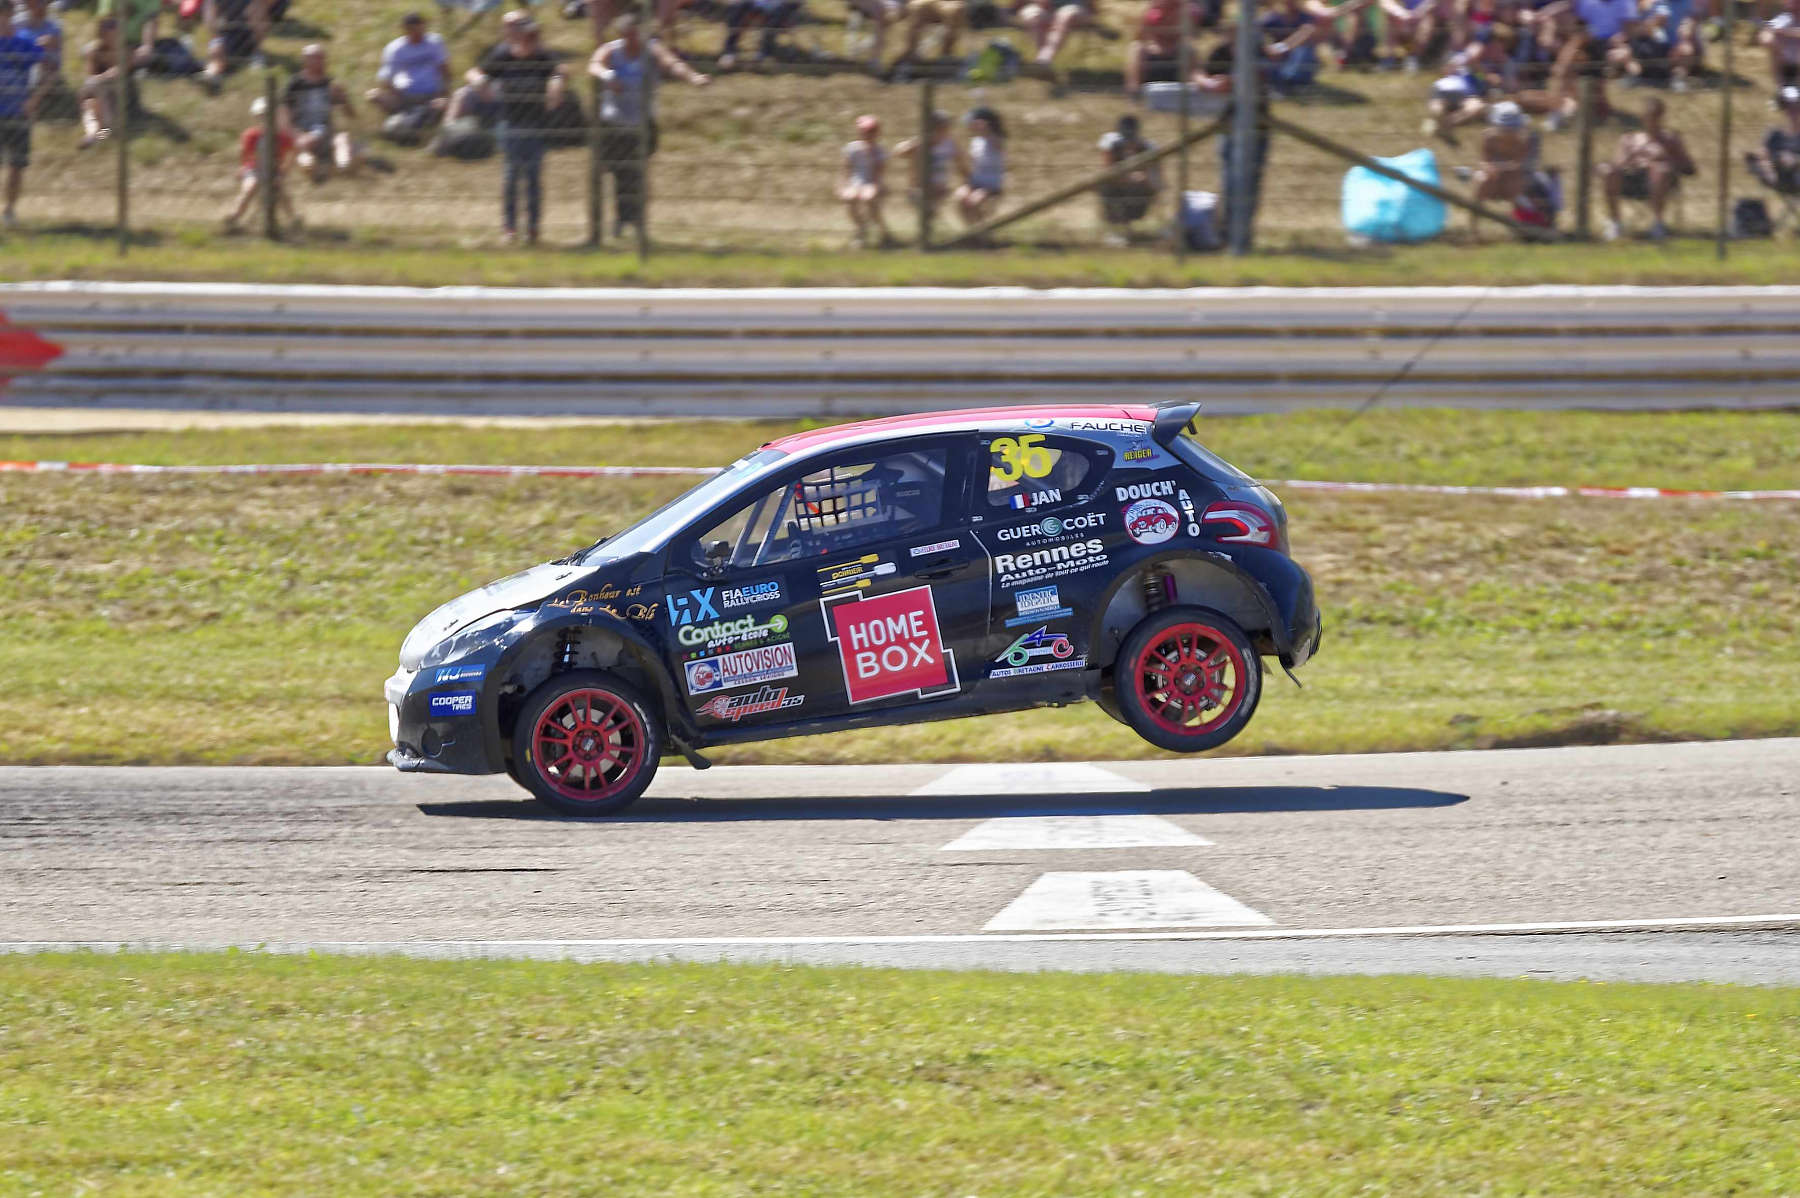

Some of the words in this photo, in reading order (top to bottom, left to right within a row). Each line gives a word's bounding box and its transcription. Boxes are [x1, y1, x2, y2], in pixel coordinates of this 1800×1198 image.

[1071, 422, 1146, 433] FAUCHE
[989, 434, 1053, 481] 35
[1031, 488, 1062, 506] JAN
[1115, 480, 1177, 502] DOUCH'
[1178, 489, 1200, 537] AUTO
[1025, 532, 1085, 547] AUTOMOBILES
[994, 538, 1105, 574] Rennes
[1000, 554, 1108, 582] Auto-Moto
[722, 590, 781, 609] RALLYCROSS
[678, 614, 756, 646] Contact
[849, 610, 929, 651] HOME
[722, 644, 794, 677] AUTOVISION
[855, 638, 935, 679] BOX
[432, 695, 473, 706] COOPER
